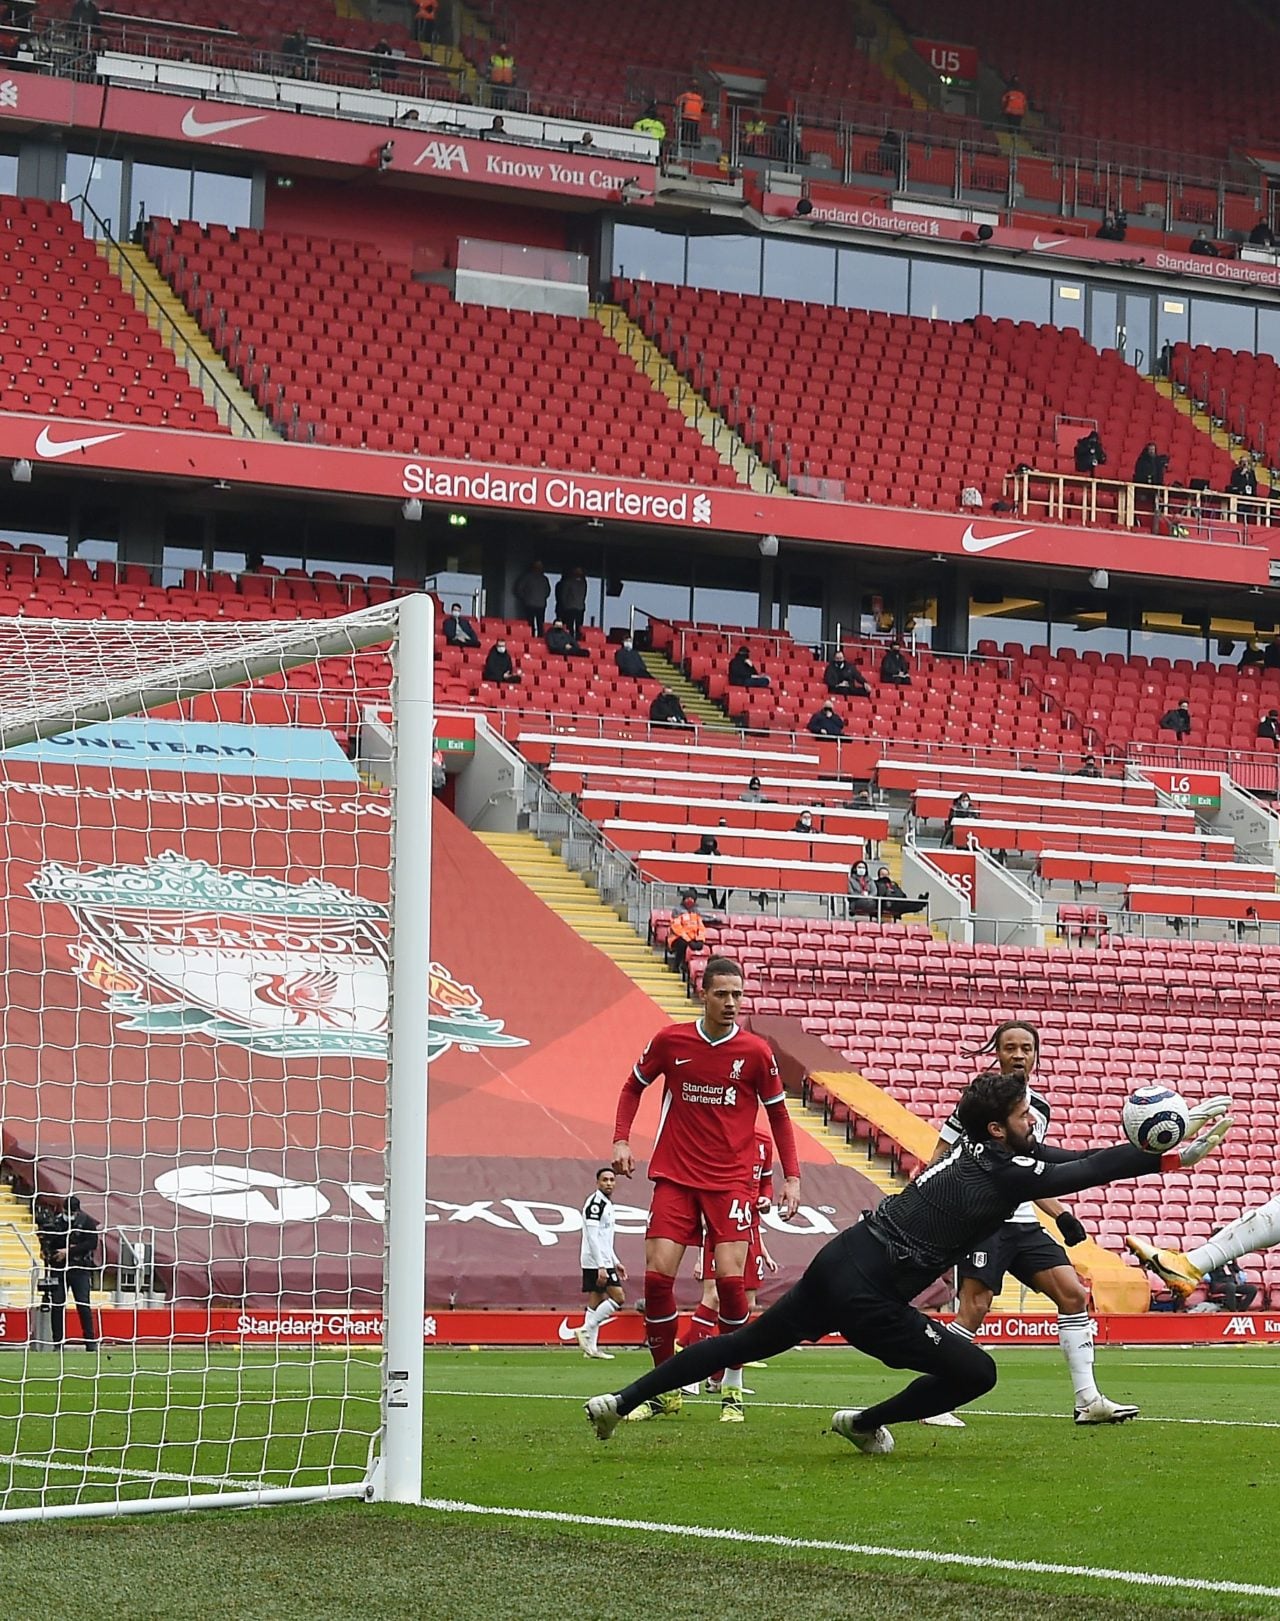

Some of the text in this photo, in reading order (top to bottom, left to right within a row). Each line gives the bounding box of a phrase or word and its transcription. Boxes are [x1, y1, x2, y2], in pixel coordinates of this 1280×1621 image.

[931, 48, 960, 71] U5
[413, 140, 469, 173] AXA
[486, 155, 626, 189] Know You Can
[807, 206, 928, 233] andard Chartered
[1156, 253, 1277, 283] Standard Chartered
[402, 463, 687, 520] Standard Chartered
[138, 739, 257, 758] TEAM
[448, 740, 464, 750] Exit
[1170, 775, 1191, 793] L6
[1198, 797, 1212, 806] Exit
[296, 903, 380, 917] ALONE
[108, 923, 374, 953] LIVERPOOL
[136, 945, 374, 966] FOOTBALL CLUB
[682, 1082, 724, 1094] Standard
[682, 1092, 722, 1105] Chartered
[728, 1199, 752, 1223] 46
[237, 1316, 387, 1335] Standard Charte
[1005, 1319, 1060, 1337] Charte
[1222, 1317, 1256, 1335] AXA
